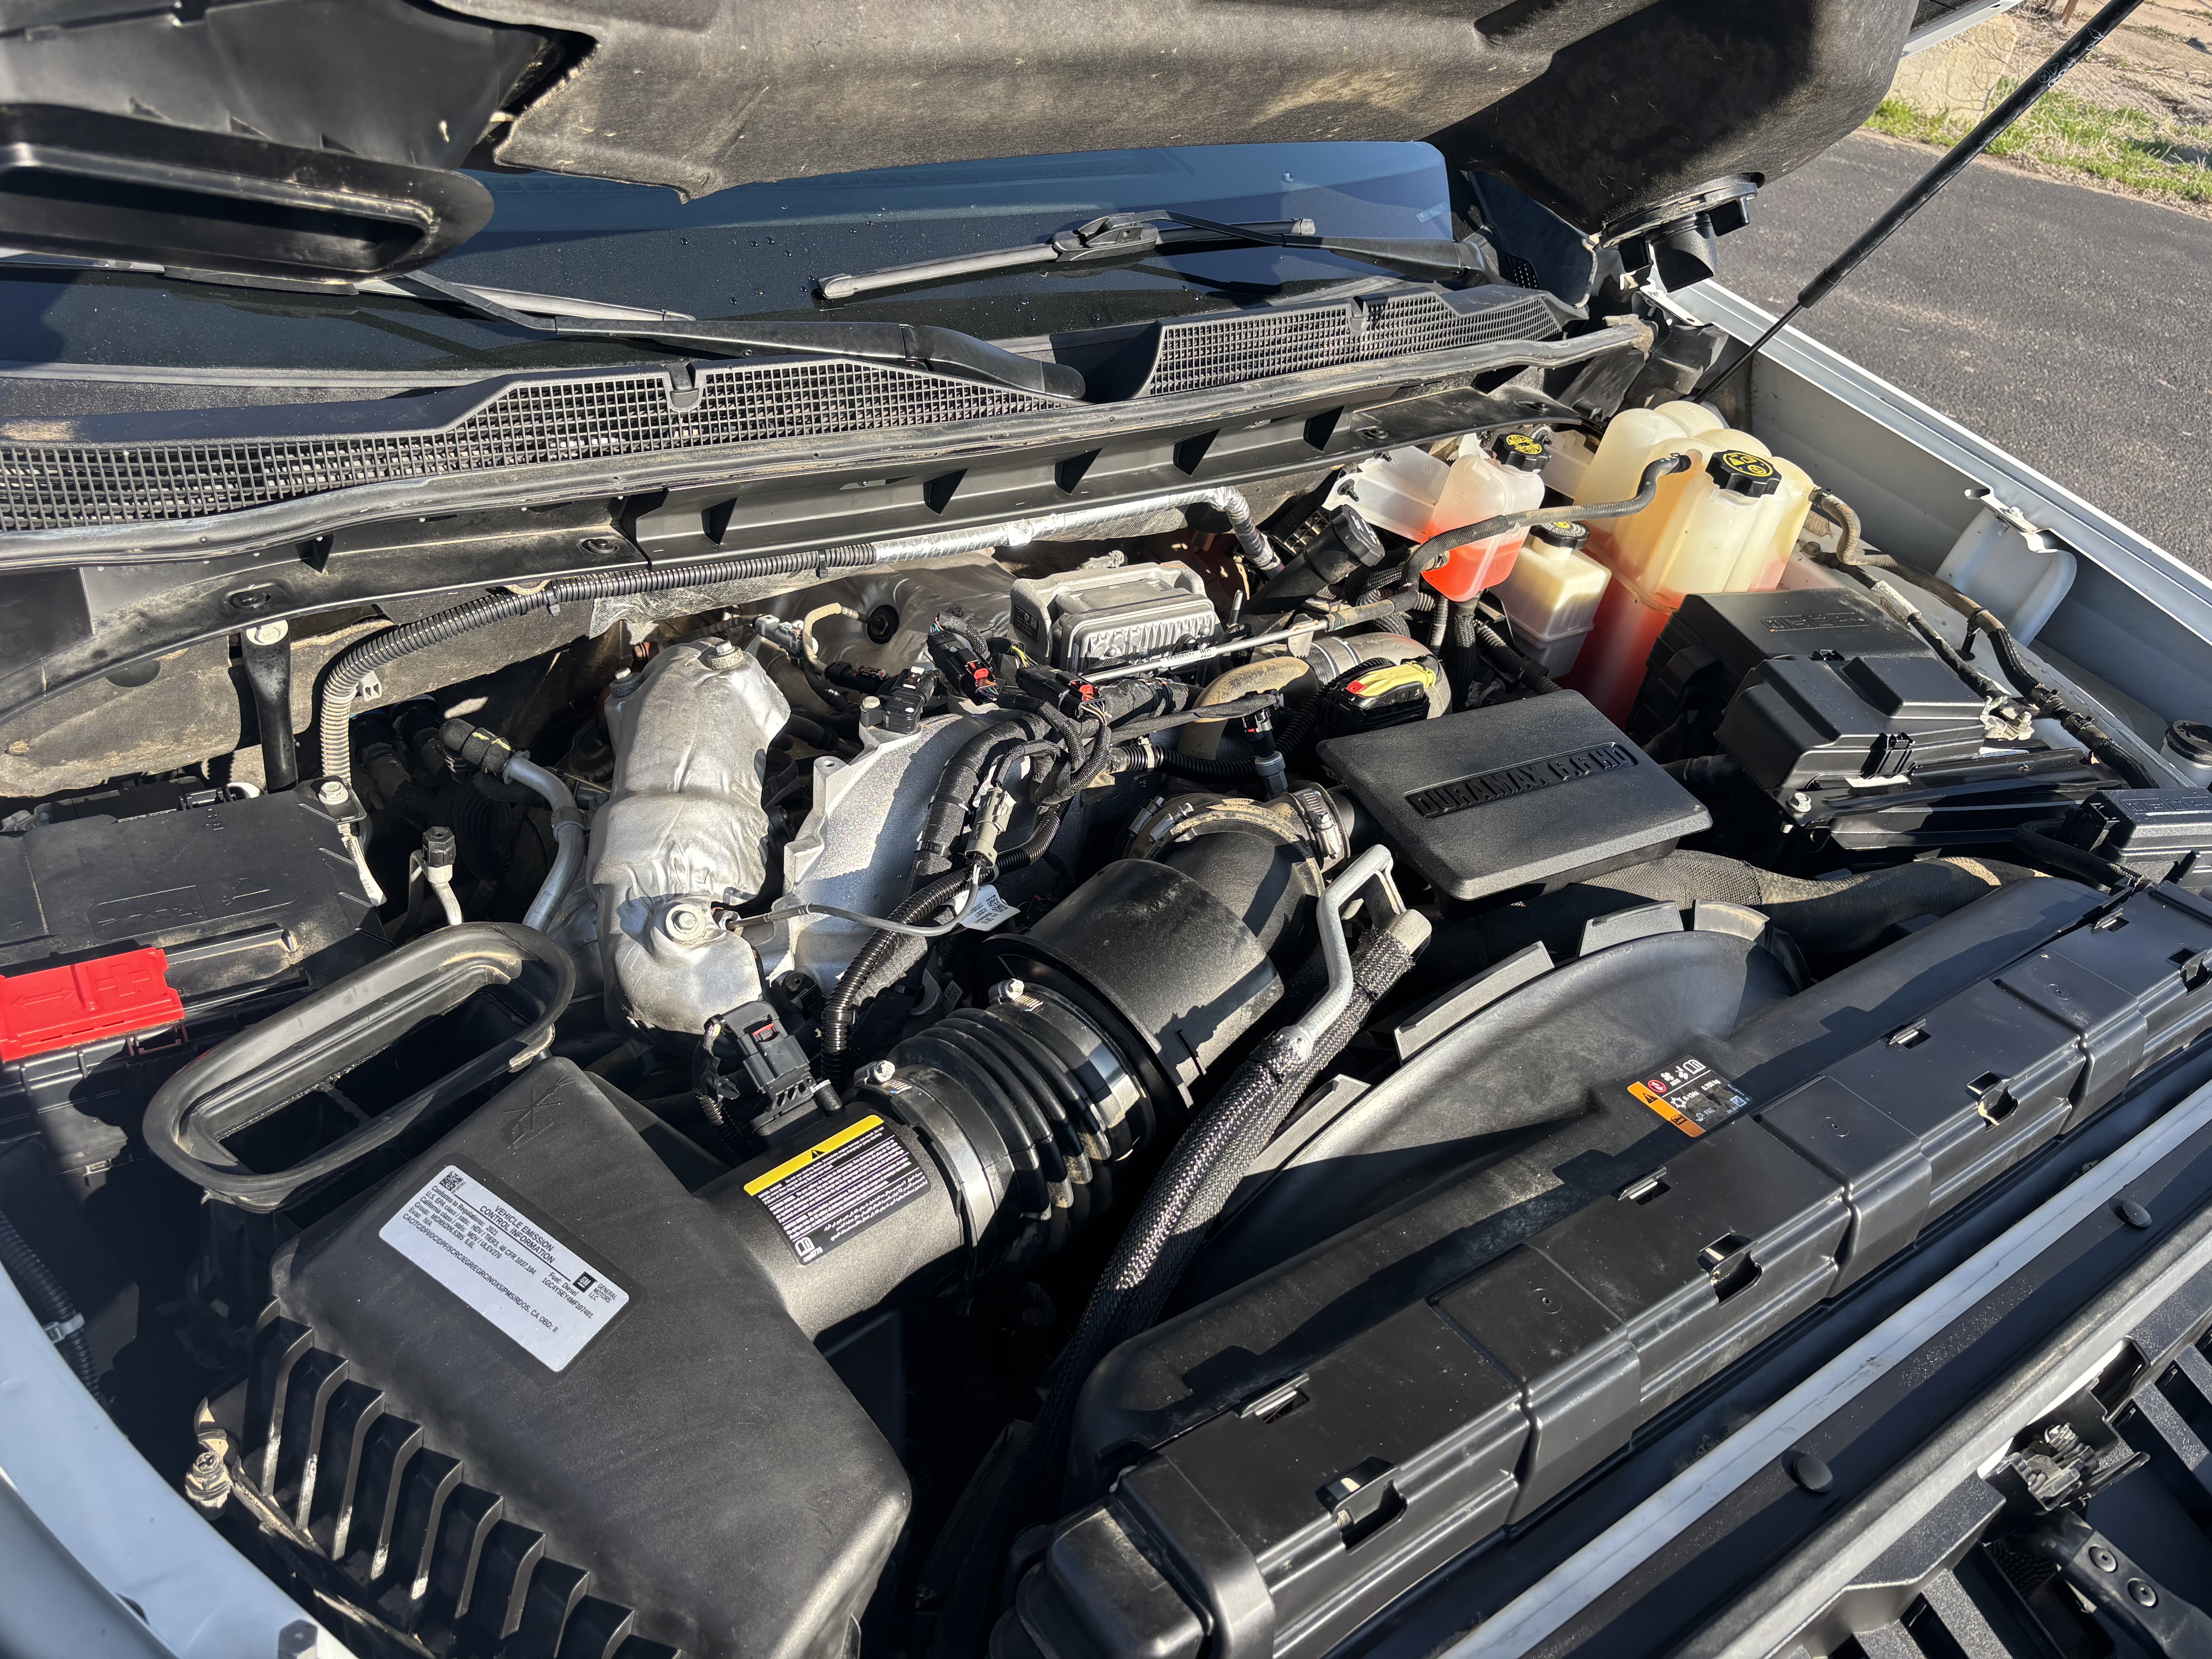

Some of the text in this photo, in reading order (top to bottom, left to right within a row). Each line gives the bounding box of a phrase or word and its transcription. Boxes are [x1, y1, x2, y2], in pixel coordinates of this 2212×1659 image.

[1413, 749, 1633, 816] DURAMAX 6.6 HD
[1683, 1091, 1700, 1101] R-134a
[1703, 1108, 1715, 1116] PAG
[409, 1207, 433, 1226] Evap: N/A
[432, 1185, 453, 1203] Conforms
[457, 1204, 486, 1226] Regulations:
[486, 1225, 498, 1237] 2021
[414, 1202, 475, 1249] Group: MGMXD06.6385 6.6L
[420, 1196, 441, 1214] California
[440, 1212, 453, 1222] class
[454, 1222, 467, 1232] stds:
[466, 1231, 480, 1242] MDV
[480, 1241, 502, 1259] ULEV270
[426, 1190, 436, 1200] U.S.
[434, 1197, 446, 1207] EPA
[444, 1205, 457, 1216] class
[458, 1215, 471, 1226] stds:
[471, 1224, 484, 1234] HDV
[484, 1233, 500, 1248] TIER3,
[505, 1249, 517, 1260] CFR
[515, 1257, 537, 1275] 1037.104
[480, 1206, 555, 1264] CONTROL INFORMATION
[495, 1205, 554, 1252] VEHICLE EMISSION
[548, 1272, 579, 1297] Fuel: Diesel
[580, 1276, 591, 1286] GM
[598, 1283, 617, 1300] GENERAL
[541, 1278, 594, 1319] 1GC4YSEY4MF107401
[588, 1291, 599, 1300] LLC
[593, 1288, 611, 1303] MOTORS
[531, 1310, 539, 1319] CA
[539, 1316, 553, 1329] OBD:
